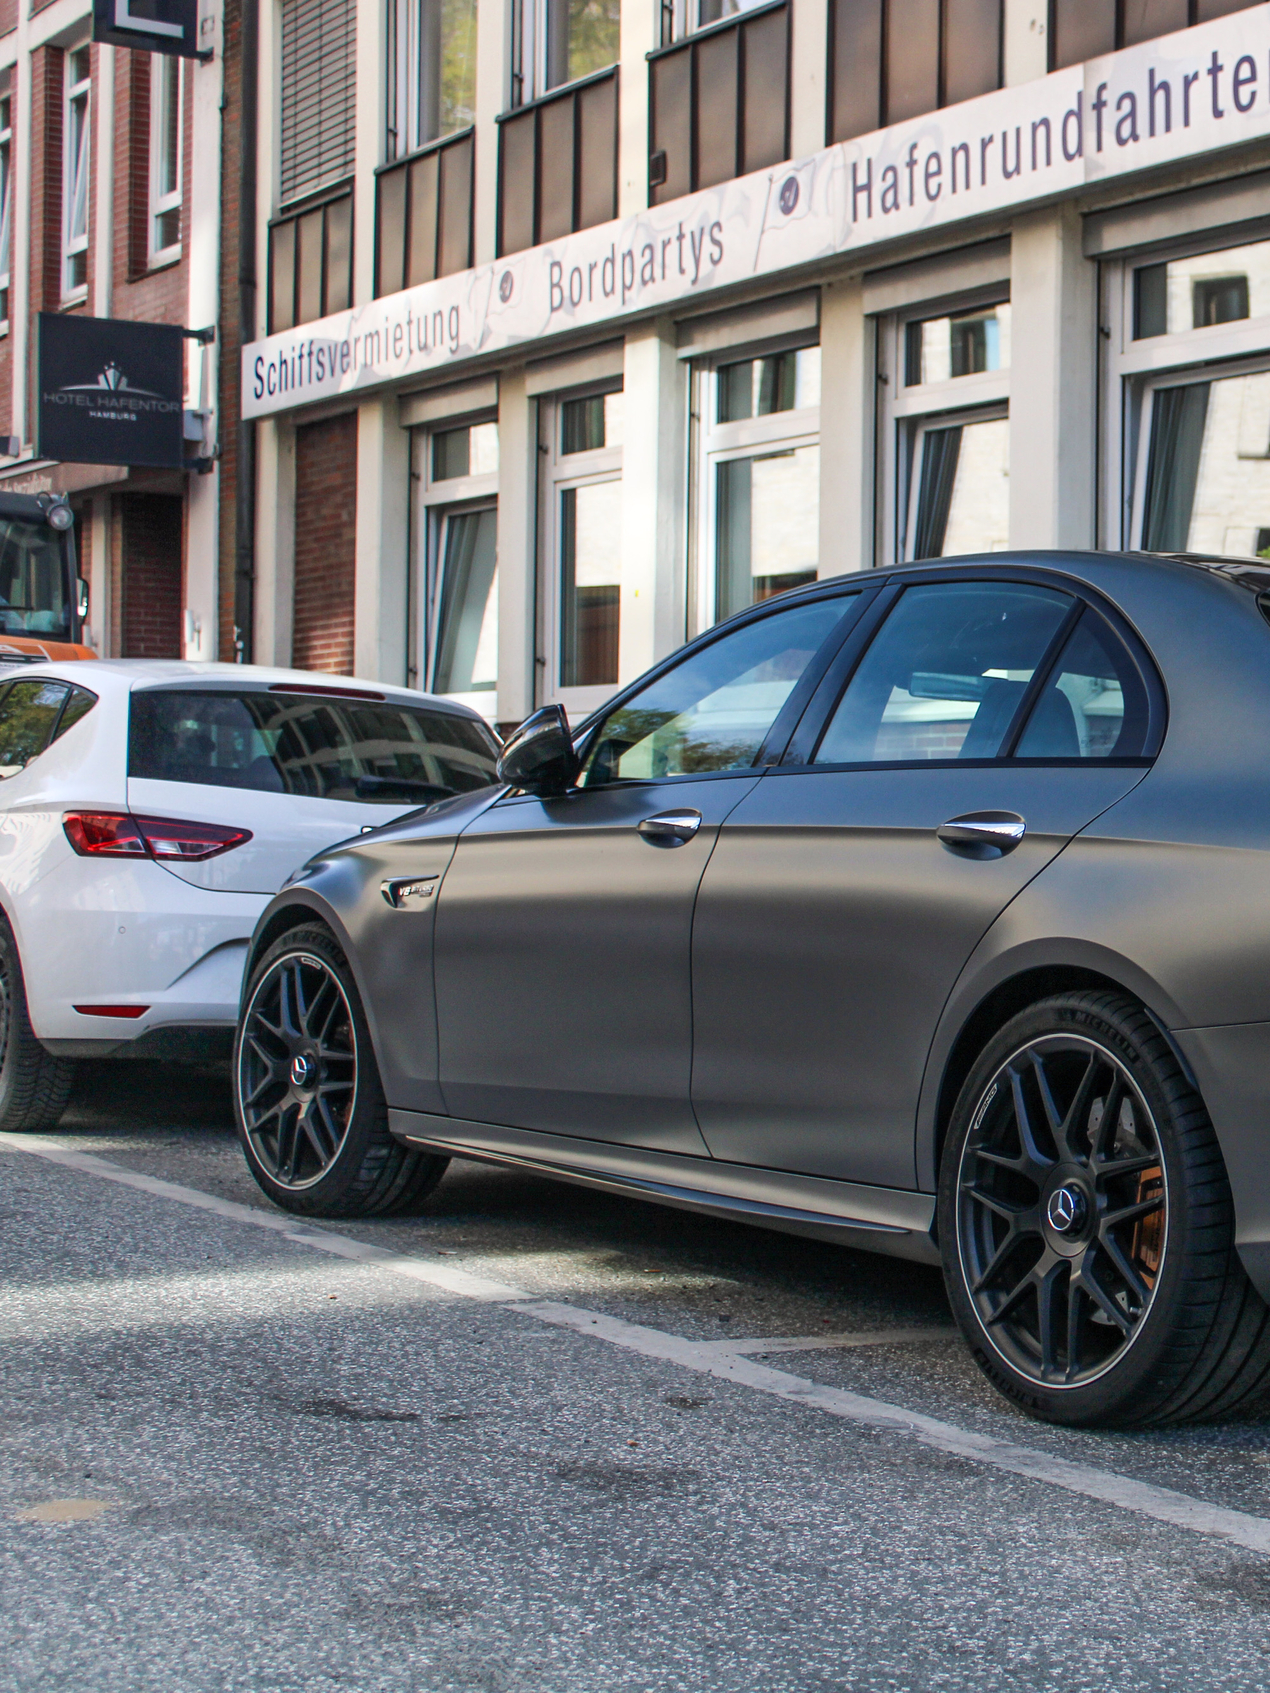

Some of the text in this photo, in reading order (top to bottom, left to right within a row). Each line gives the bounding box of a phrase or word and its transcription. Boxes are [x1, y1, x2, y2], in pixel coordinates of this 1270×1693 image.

[548, 218, 726, 313] Bordpartys
[252, 302, 462, 401] Schiffsvermietung
[44, 392, 180, 413] HOTEL HAFENTOR
[89, 410, 137, 422] HAMBURG
